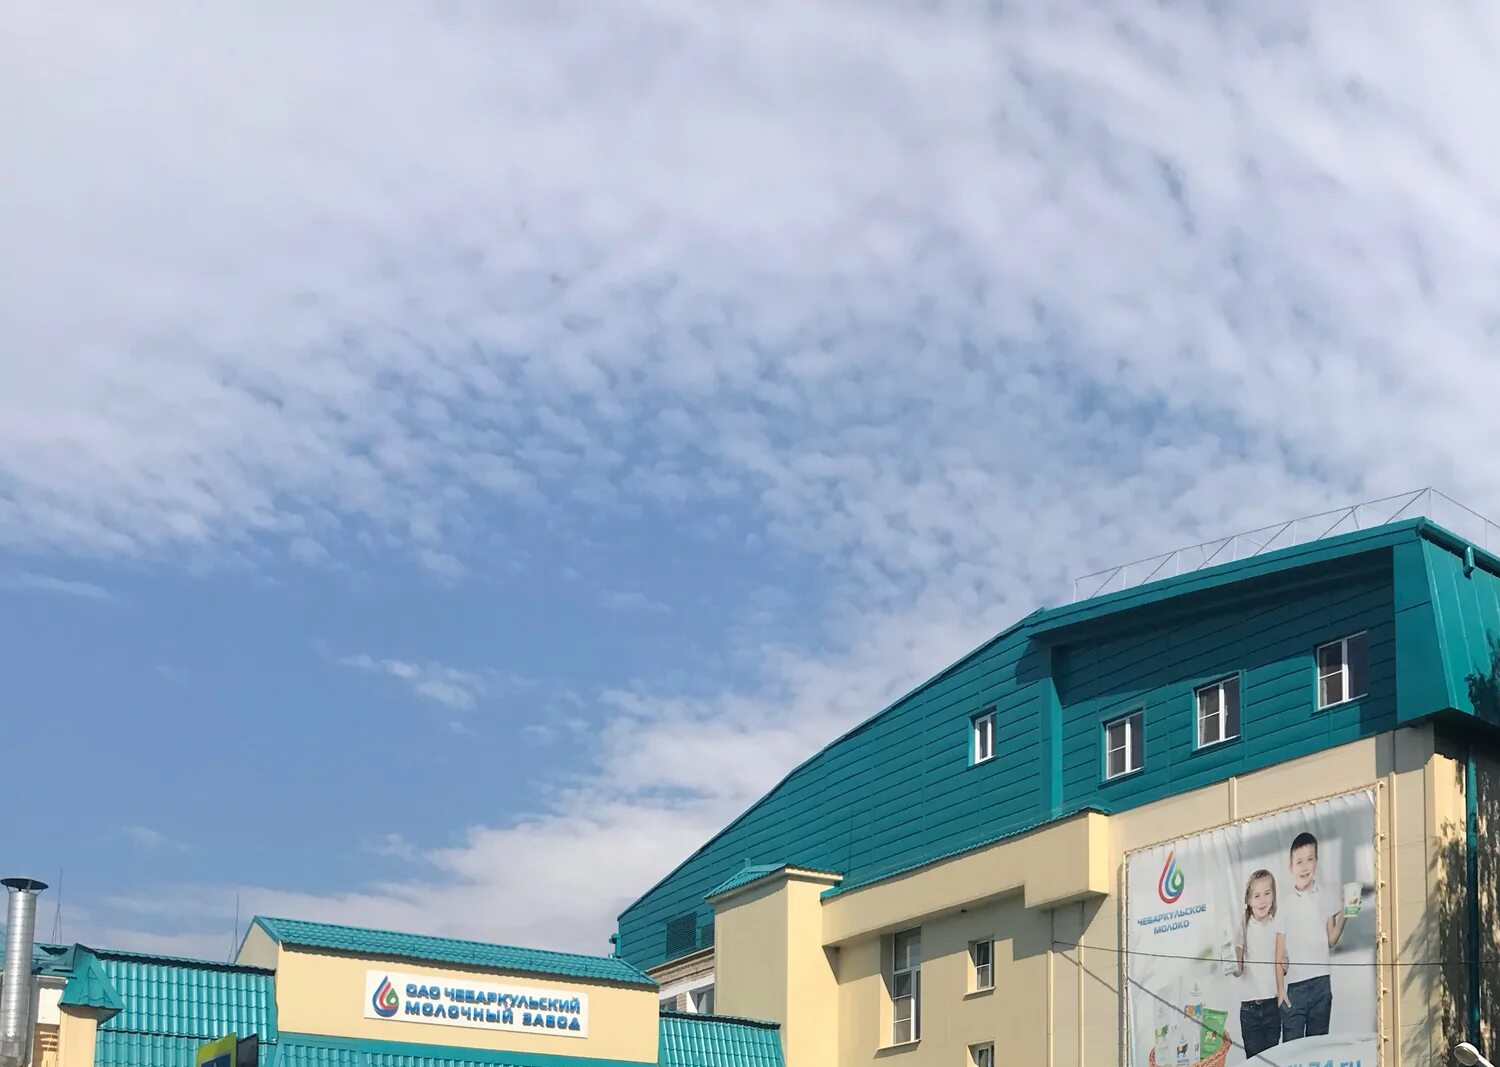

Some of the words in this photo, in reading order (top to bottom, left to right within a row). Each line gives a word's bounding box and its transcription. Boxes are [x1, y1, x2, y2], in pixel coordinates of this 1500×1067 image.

[1137, 904, 1207, 926] ЧЕБАРКУЛЬСКОЕ
[1153, 919, 1190, 935] МОЛОКО
[405, 983, 441, 1000] ОАО
[444, 987, 581, 1015] ЧЕБАРКУЛЬСКИЙ
[404, 1001, 514, 1025] МОЛОЧНЫЙ
[522, 1012, 581, 1031] ЗАВОД
